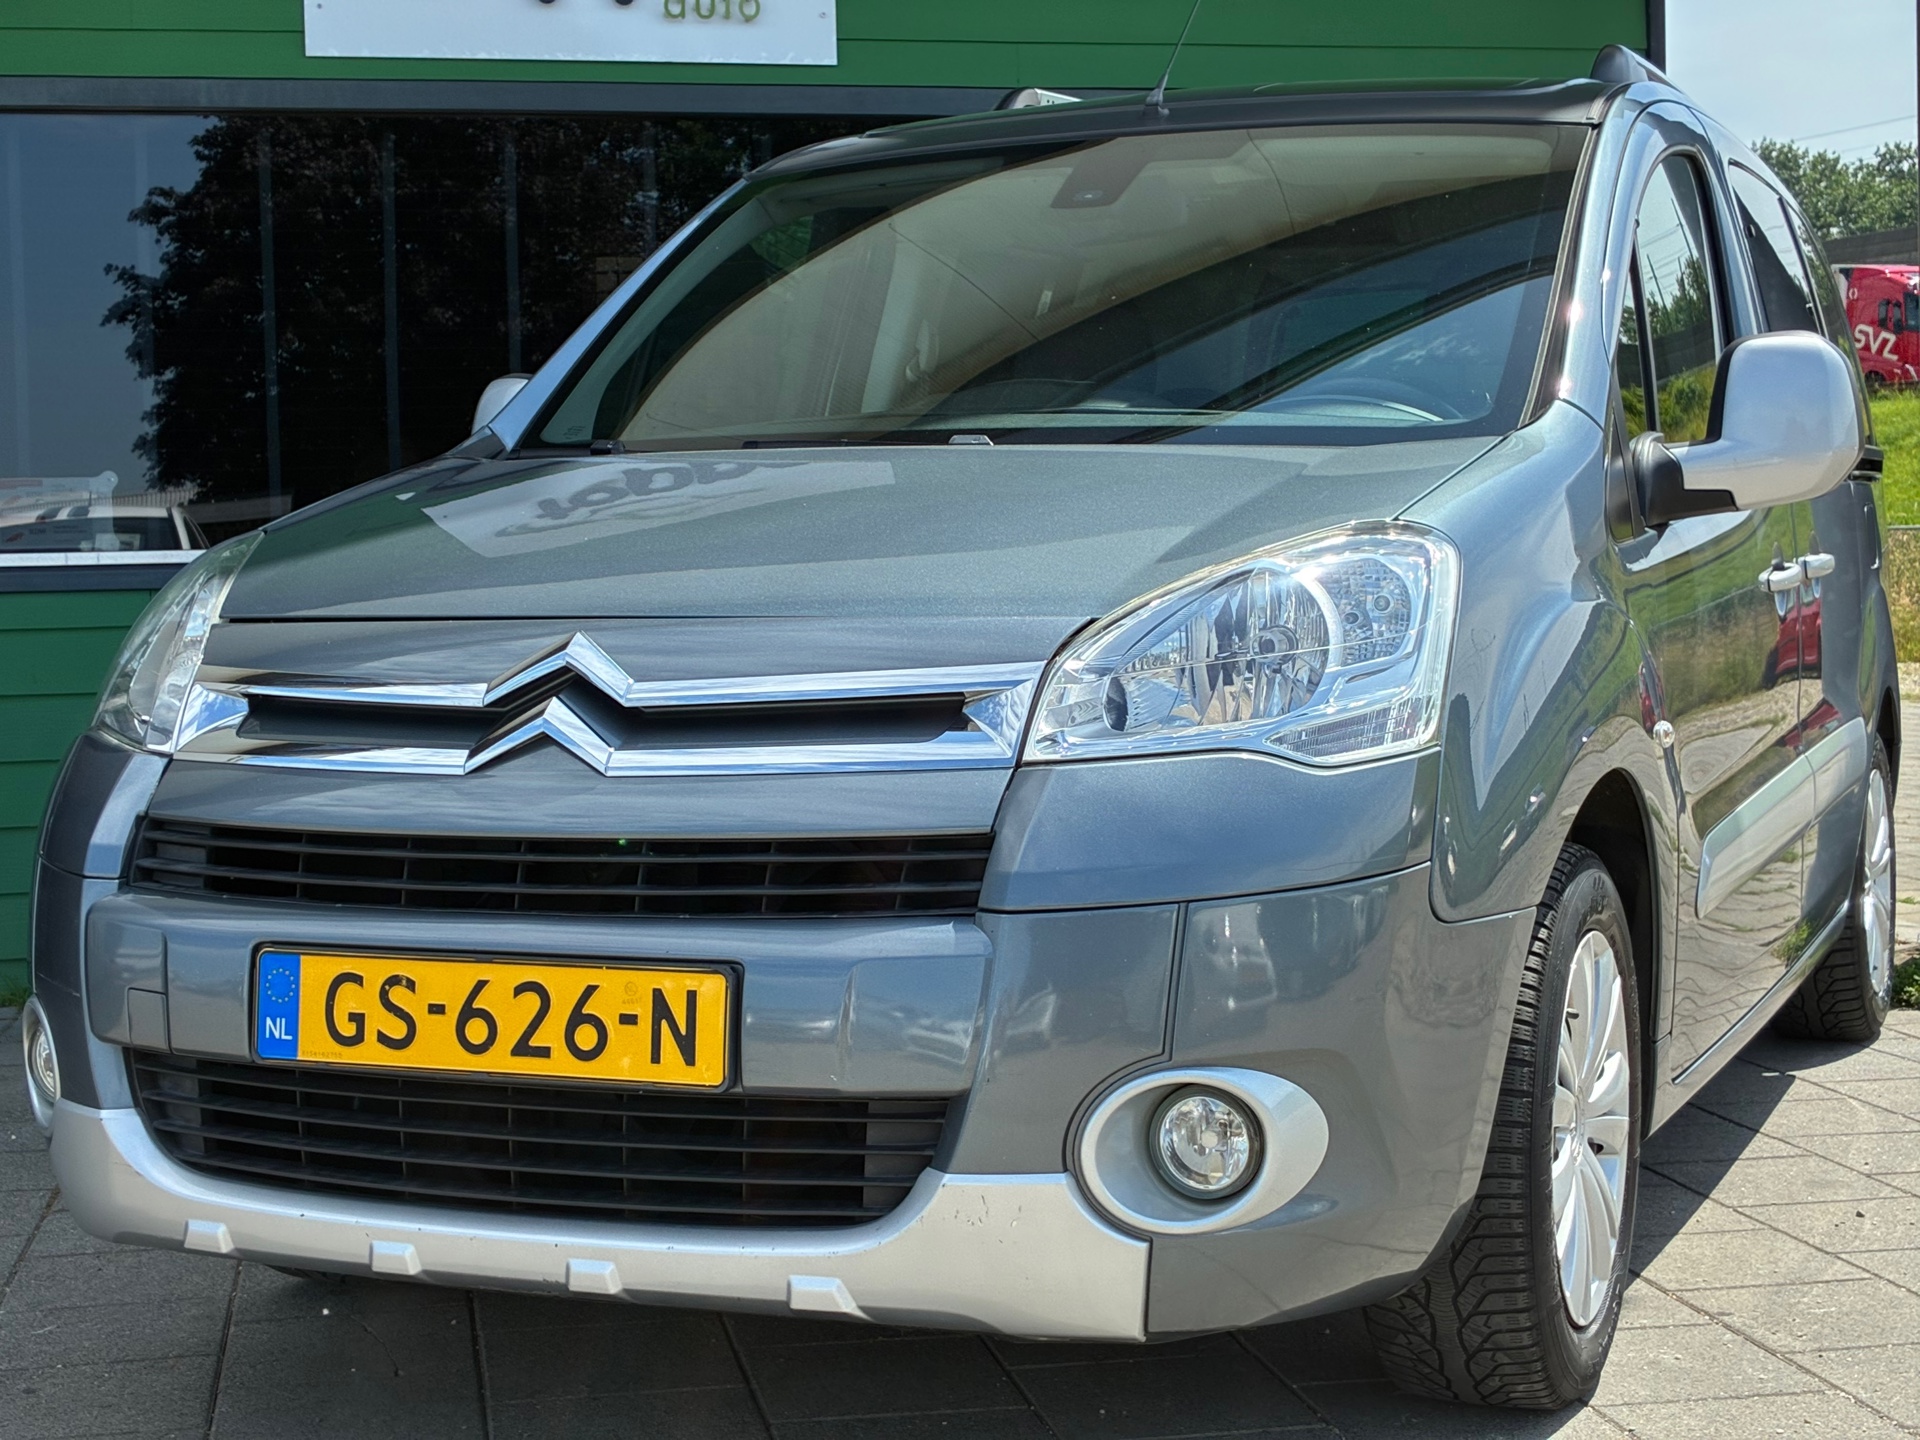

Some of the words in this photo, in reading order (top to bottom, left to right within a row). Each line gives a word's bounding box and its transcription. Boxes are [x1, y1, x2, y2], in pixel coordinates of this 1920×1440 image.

[1854, 323, 1899, 361] SVZ
[265, 1015, 293, 1041] NL
[324, 971, 698, 1067] GS-626-N
